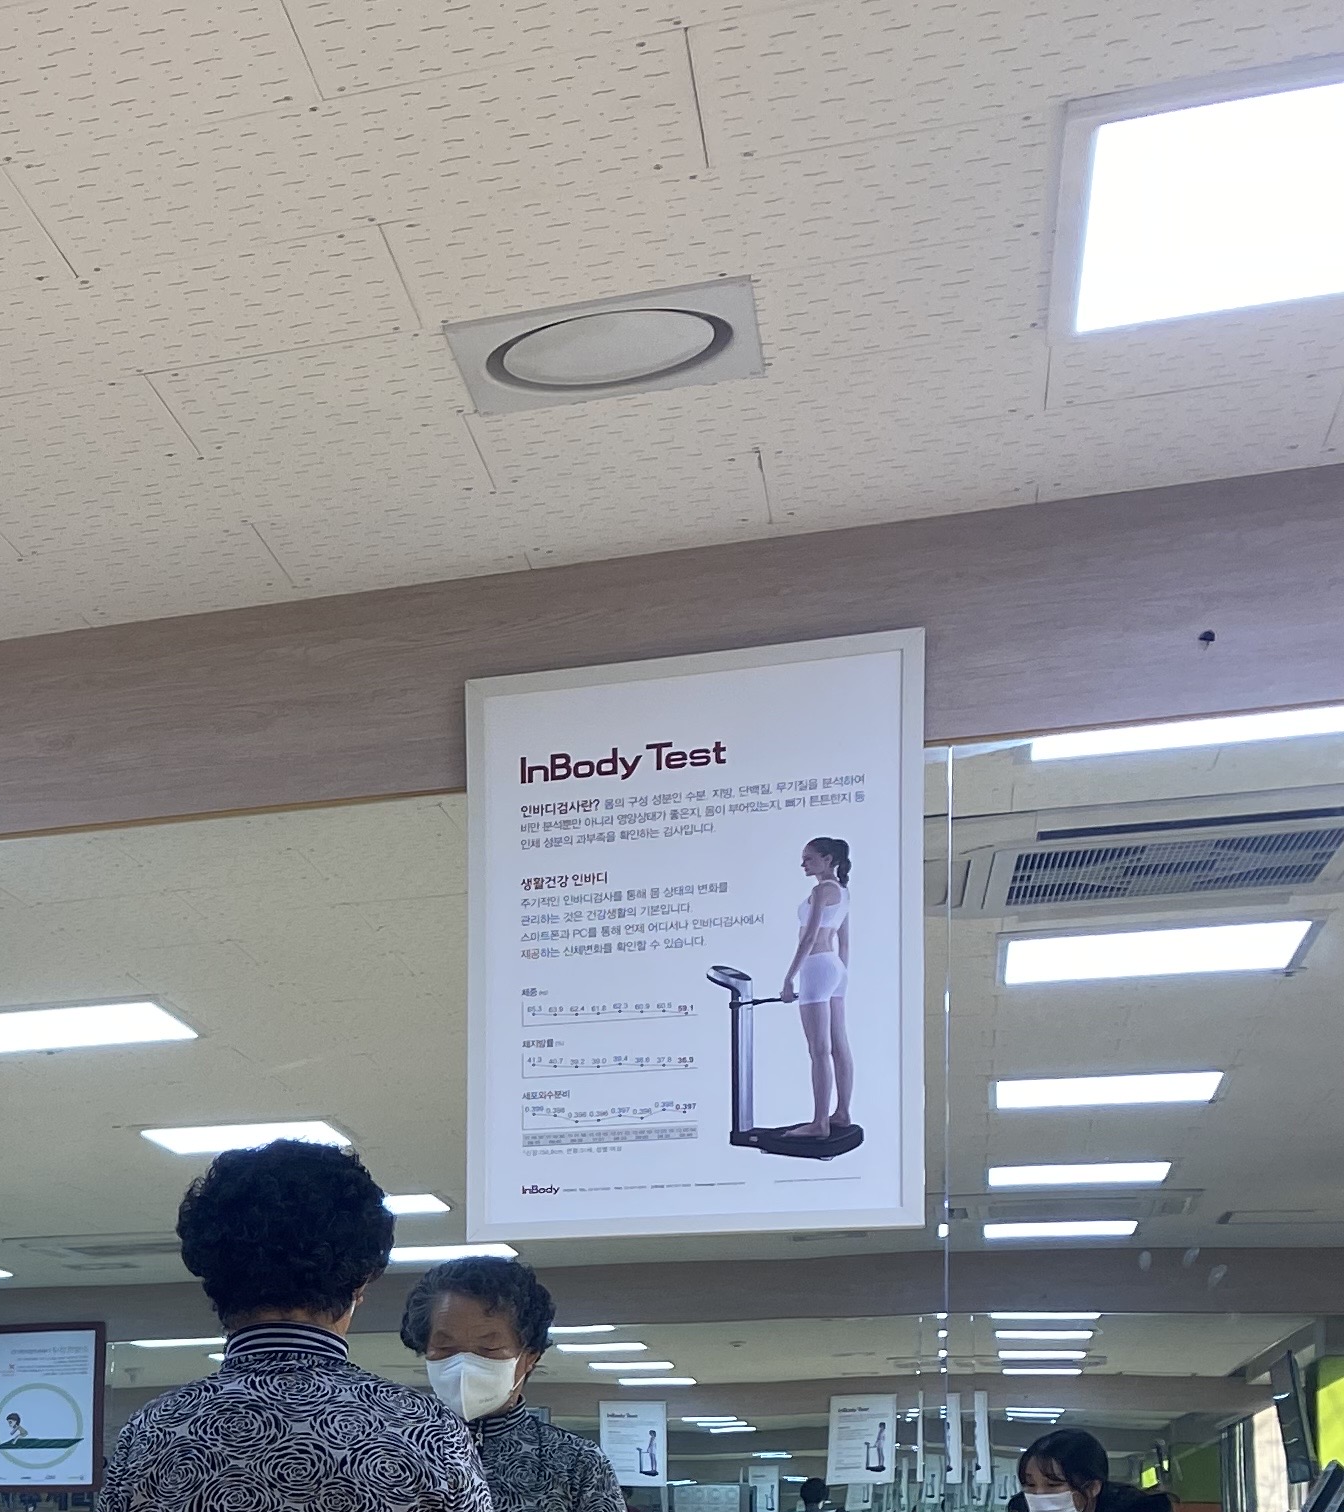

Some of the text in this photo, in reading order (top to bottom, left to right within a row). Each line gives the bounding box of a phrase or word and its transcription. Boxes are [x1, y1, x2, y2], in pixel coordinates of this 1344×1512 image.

[520, 741, 727, 785] InBody Test
[520, 798, 601, 818] 인바디검사란?
[520, 871, 609, 892] 생활건강 인바디
[520, 881, 729, 909] 주기적인 인바디검사를 통해 몸 상태의 변화를
[520, 912, 561, 927] 관리하는
[563, 910, 584, 923] 것은
[586, 906, 638, 921] 건강생활의
[520, 912, 766, 943] 스마트폰과 PC를 통해 언제 어디서나 인바디검사에서
[520, 946, 561, 961] 제공하는
[563, 942, 613, 958] 신체변화를
[616, 940, 647, 953] 확인할
[649, 939, 661, 951] 수
[521, 1184, 561, 1195] InBody
